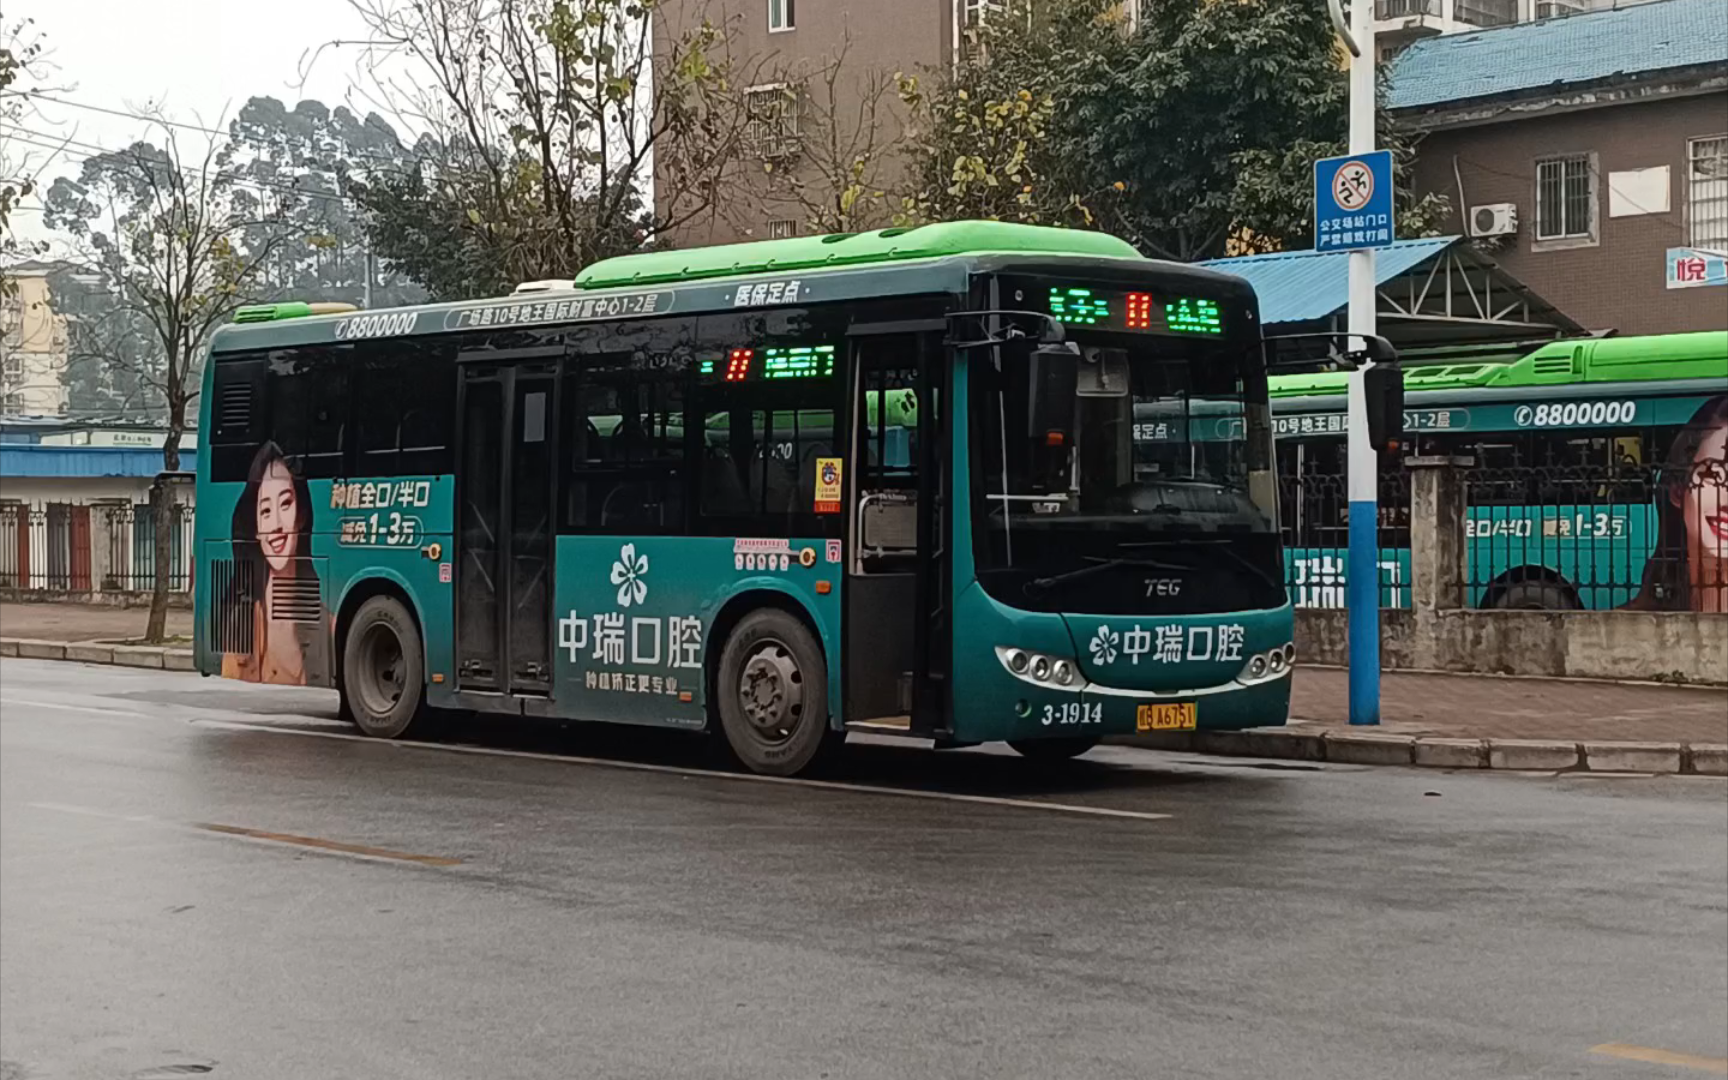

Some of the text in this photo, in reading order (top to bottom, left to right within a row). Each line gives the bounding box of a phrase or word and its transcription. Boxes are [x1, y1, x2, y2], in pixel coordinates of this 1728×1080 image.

[734, 281, 801, 307] 医保定点
[346, 311, 418, 339] 8800000
[1534, 401, 1636, 426] 8800000
[331, 481, 430, 509] 种植全口/半口
[1144, 578, 1182, 597] TEG
[558, 609, 703, 668] 中瑞口腔
[1123, 623, 1245, 665] 中瑞口腔
[1041, 702, 1103, 726] 3-1914
